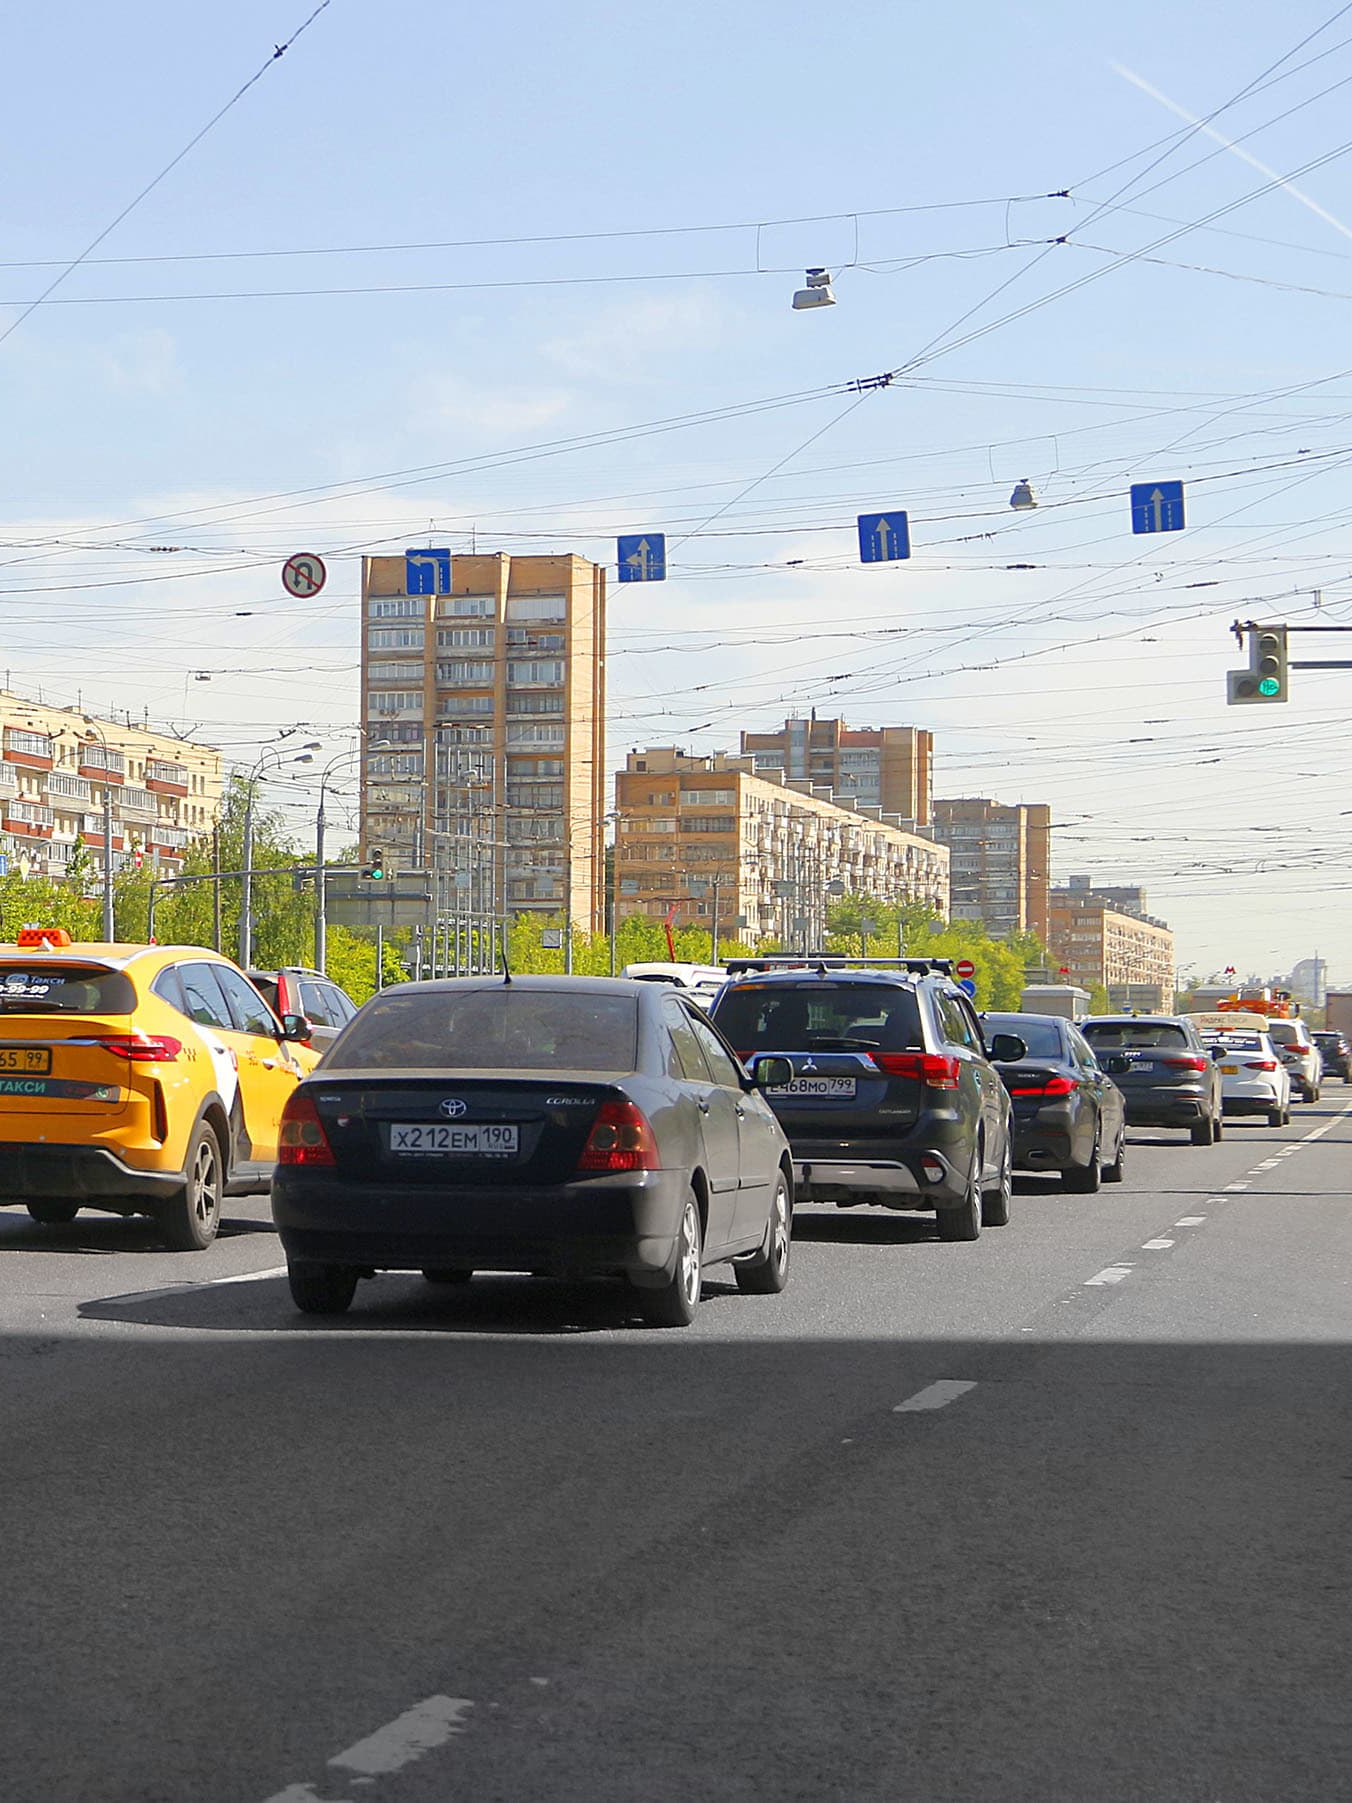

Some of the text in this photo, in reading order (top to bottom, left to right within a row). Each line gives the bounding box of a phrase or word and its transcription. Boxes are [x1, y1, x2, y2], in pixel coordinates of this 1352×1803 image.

[31, 975, 66, 985] Такси
[27, 1051, 42, 1064] 99
[830, 1079, 852, 1089] 799
[397, 1127, 512, 1149] Х212ЕМ 190
